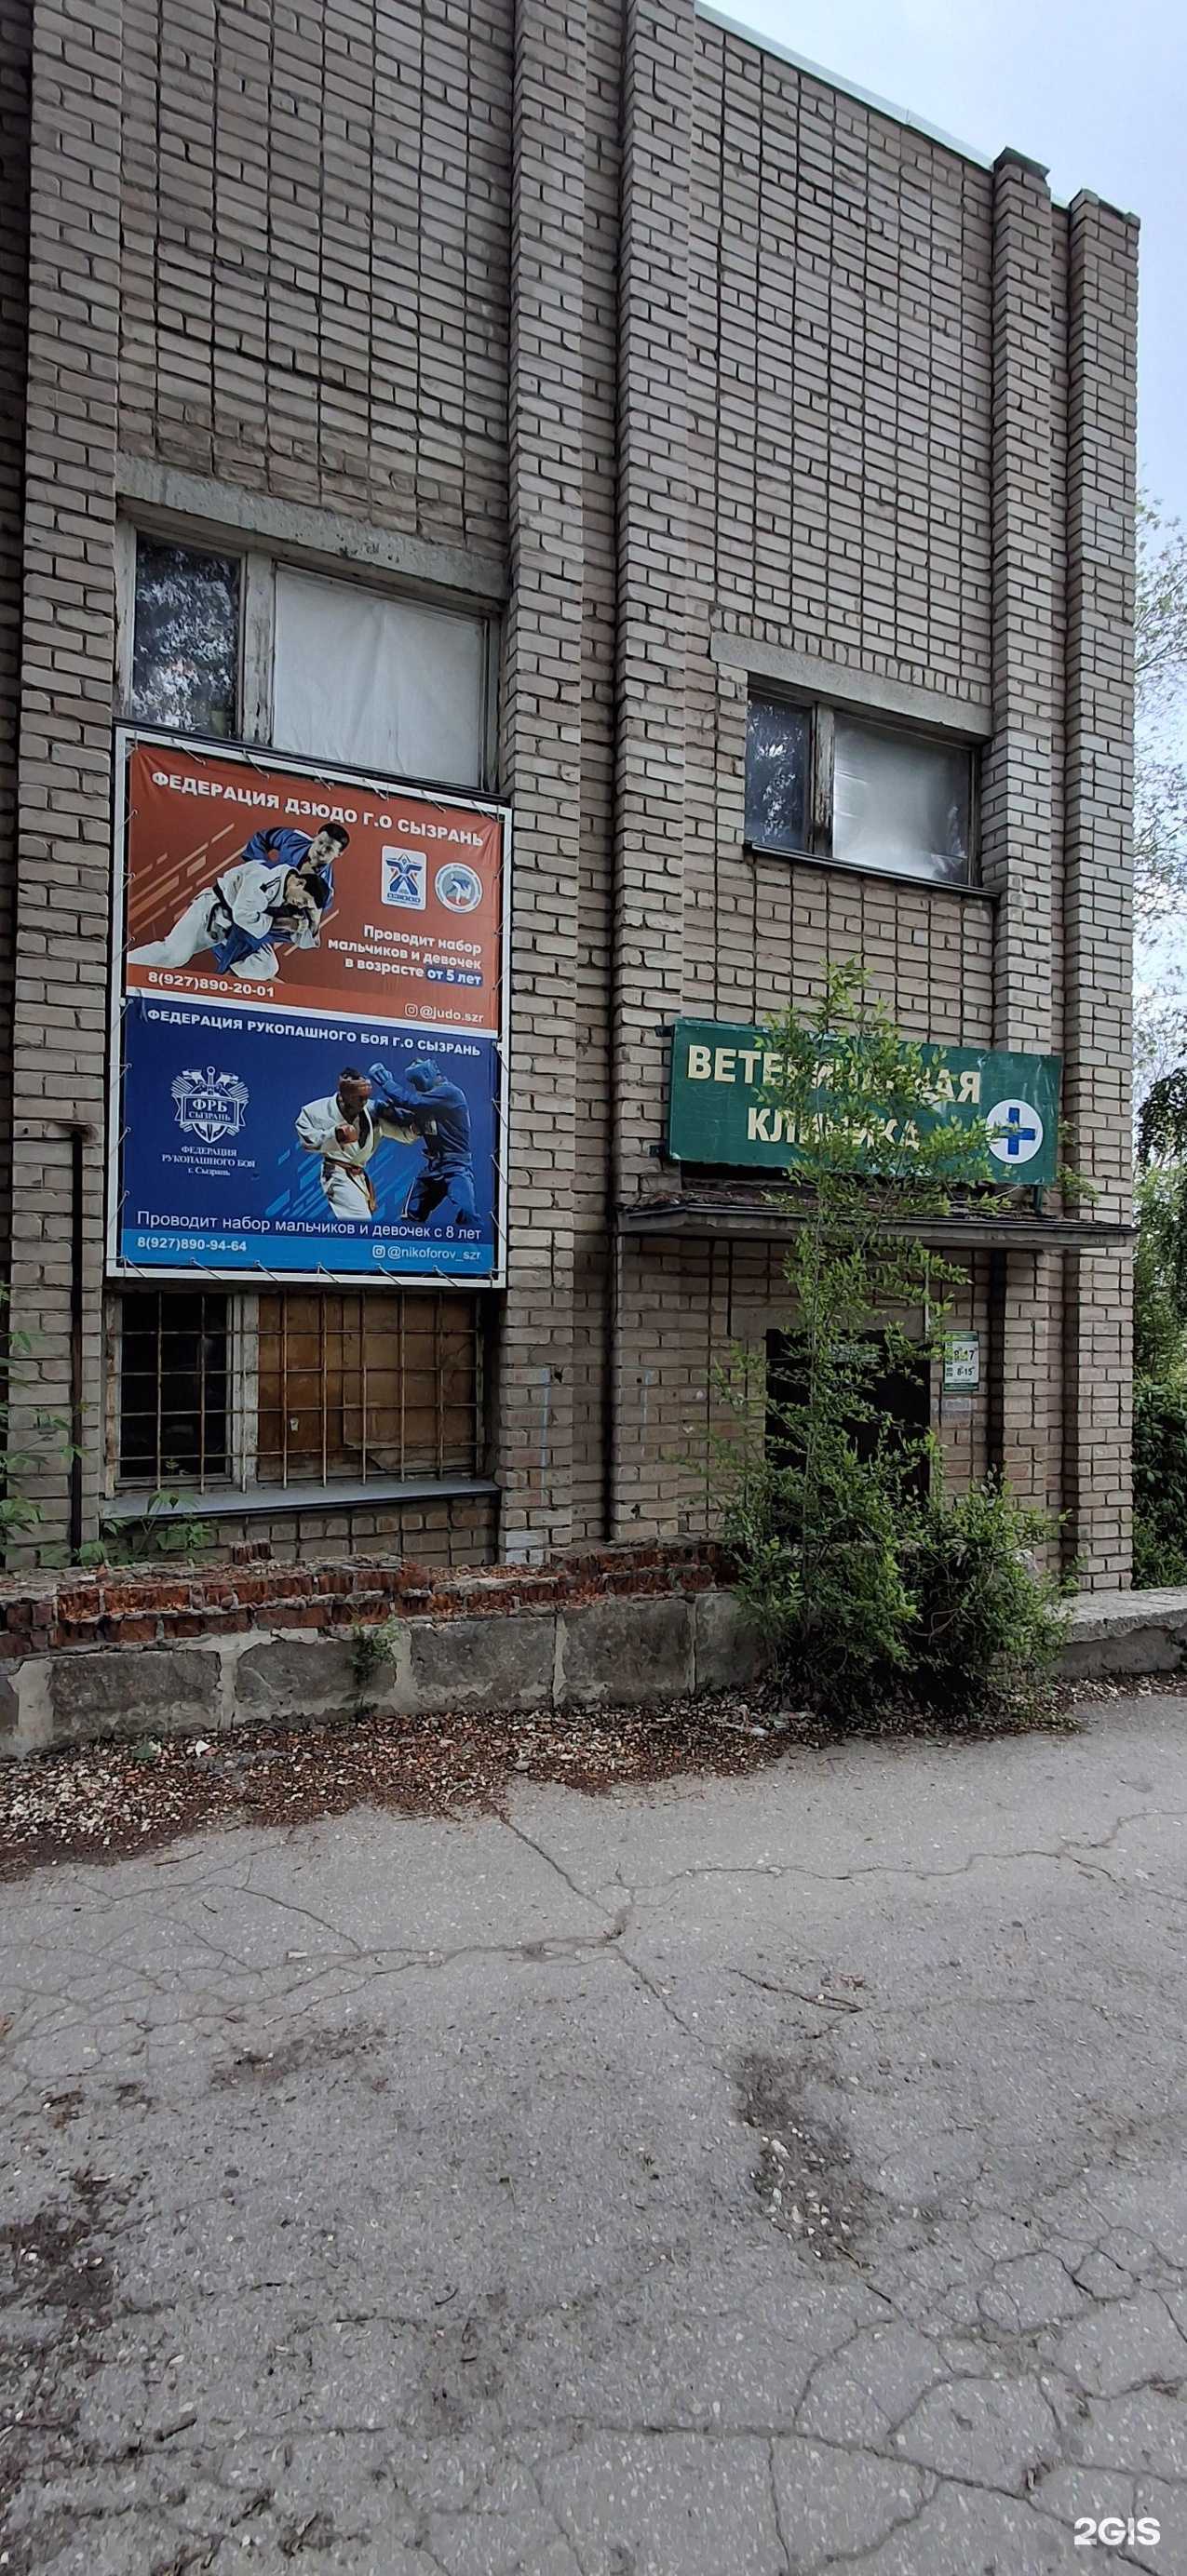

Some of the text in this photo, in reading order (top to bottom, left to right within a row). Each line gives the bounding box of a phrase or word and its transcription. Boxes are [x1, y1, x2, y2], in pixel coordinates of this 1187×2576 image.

[152, 771, 484, 847] ФЕДЕРАЦИЯ ДЗЮДО Г.О СЫЗРАНЬ
[363, 924, 482, 956] Проводит набор
[328, 939, 482, 970] мальчиков и девочек
[344, 958, 482, 986] в возрасте от 5 лет
[148, 972, 275, 998] 8(927)890-20-01
[420, 1006, 484, 1023] @judo.szr
[147, 1009, 481, 1056] ФЕДЕРАЦИЯ РУКОПАШНОГО БОЯ Г.О СЫЗРАНЬ
[188, 1111, 231, 1121] СЫЗРАНЬ
[192, 1099, 228, 1112] ФРБ
[162, 1154, 256, 1168] РУКОПАШНОГО БОЯ
[181, 1146, 237, 1157] ФЕДЕРАЦИЯ
[137, 1211, 482, 1240] Проводит набор мальчиков и девочек с 8 лет
[137, 1236, 247, 1252] 8(927)890-94-64
[387, 1245, 481, 1262] @nikoforov_szr
